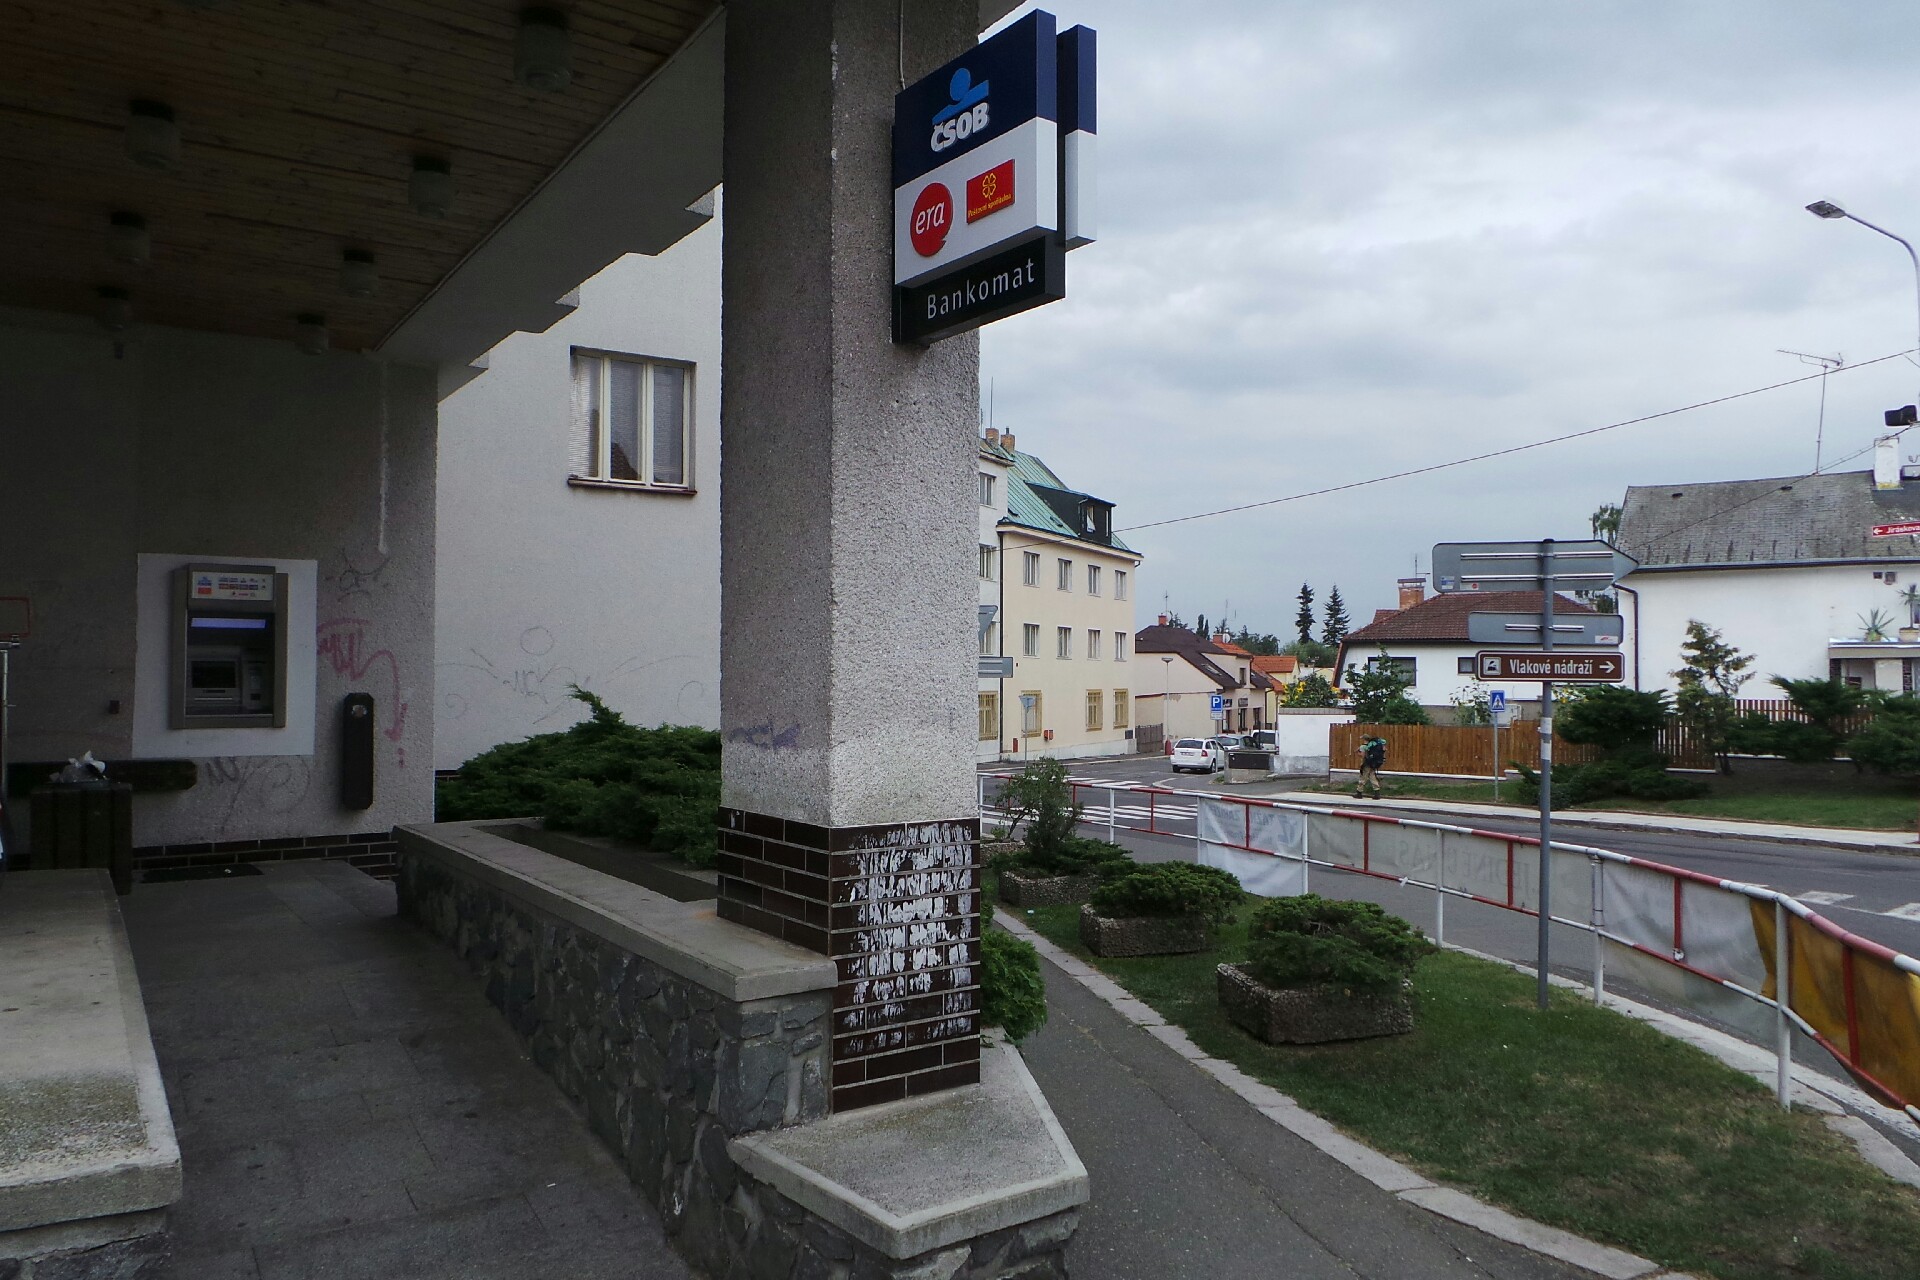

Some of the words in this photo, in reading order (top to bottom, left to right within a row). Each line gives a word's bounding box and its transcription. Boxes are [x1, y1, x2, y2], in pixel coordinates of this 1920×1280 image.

[931, 102, 989, 152] ČSOB
[915, 202, 945, 235] era
[927, 258, 1035, 319] Bankomat
[1509, 659, 1551, 674] Vlakové
[1554, 659, 1593, 674] nádraží
[1212, 696, 1221, 708] P
